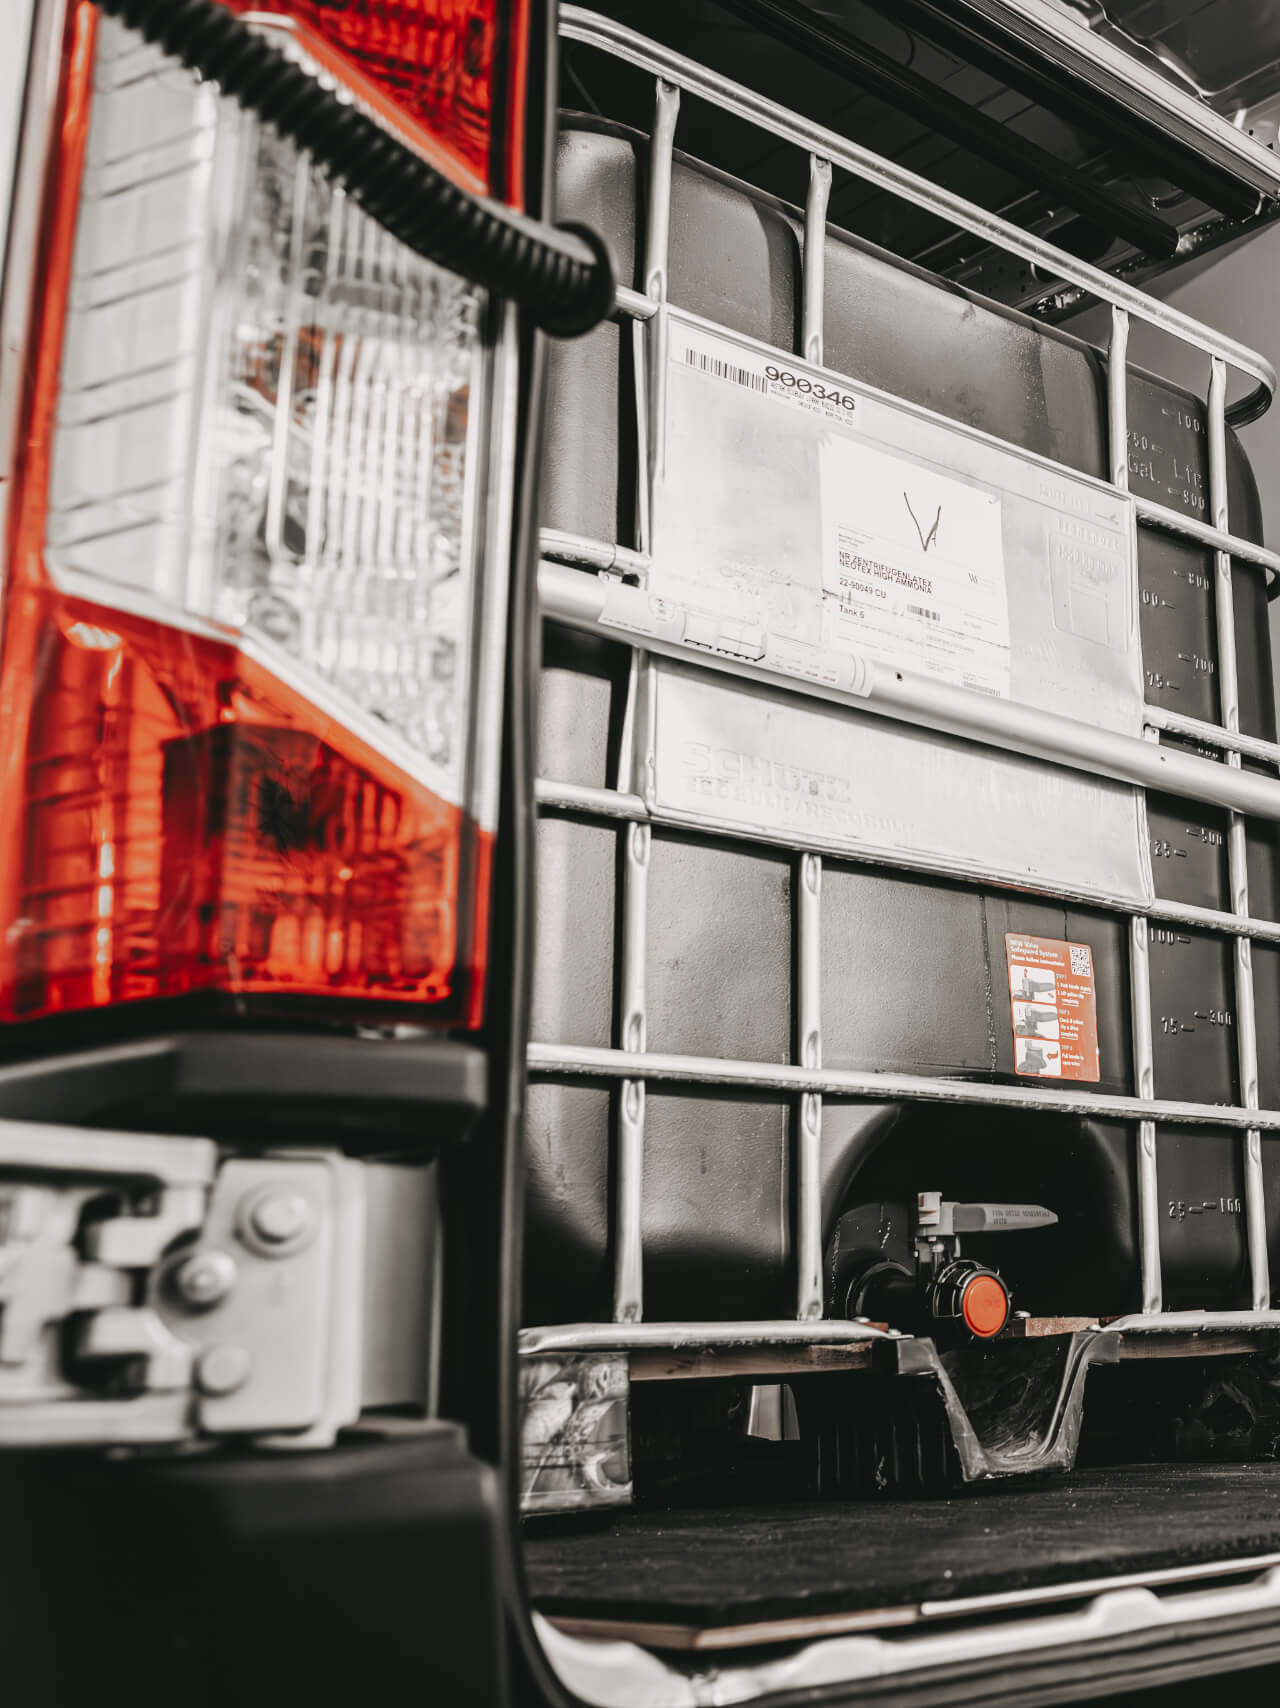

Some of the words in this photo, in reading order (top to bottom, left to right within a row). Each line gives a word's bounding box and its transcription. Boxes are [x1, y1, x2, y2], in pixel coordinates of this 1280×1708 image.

[765, 365, 856, 411] 900346
[839, 551, 851, 561] NR
[839, 558, 872, 576] NEOTEX
[874, 570, 893, 583] HIGH
[895, 577, 932, 594] AMMONIA
[1142, 589, 1160, 608] 00
[839, 605, 858, 617] Tank
[1147, 671, 1164, 688] 75
[1154, 840, 1171, 858] 25
[1150, 927, 1175, 946] 100
[1161, 1017, 1178, 1034] 75
[1168, 1201, 1185, 1219] 25
